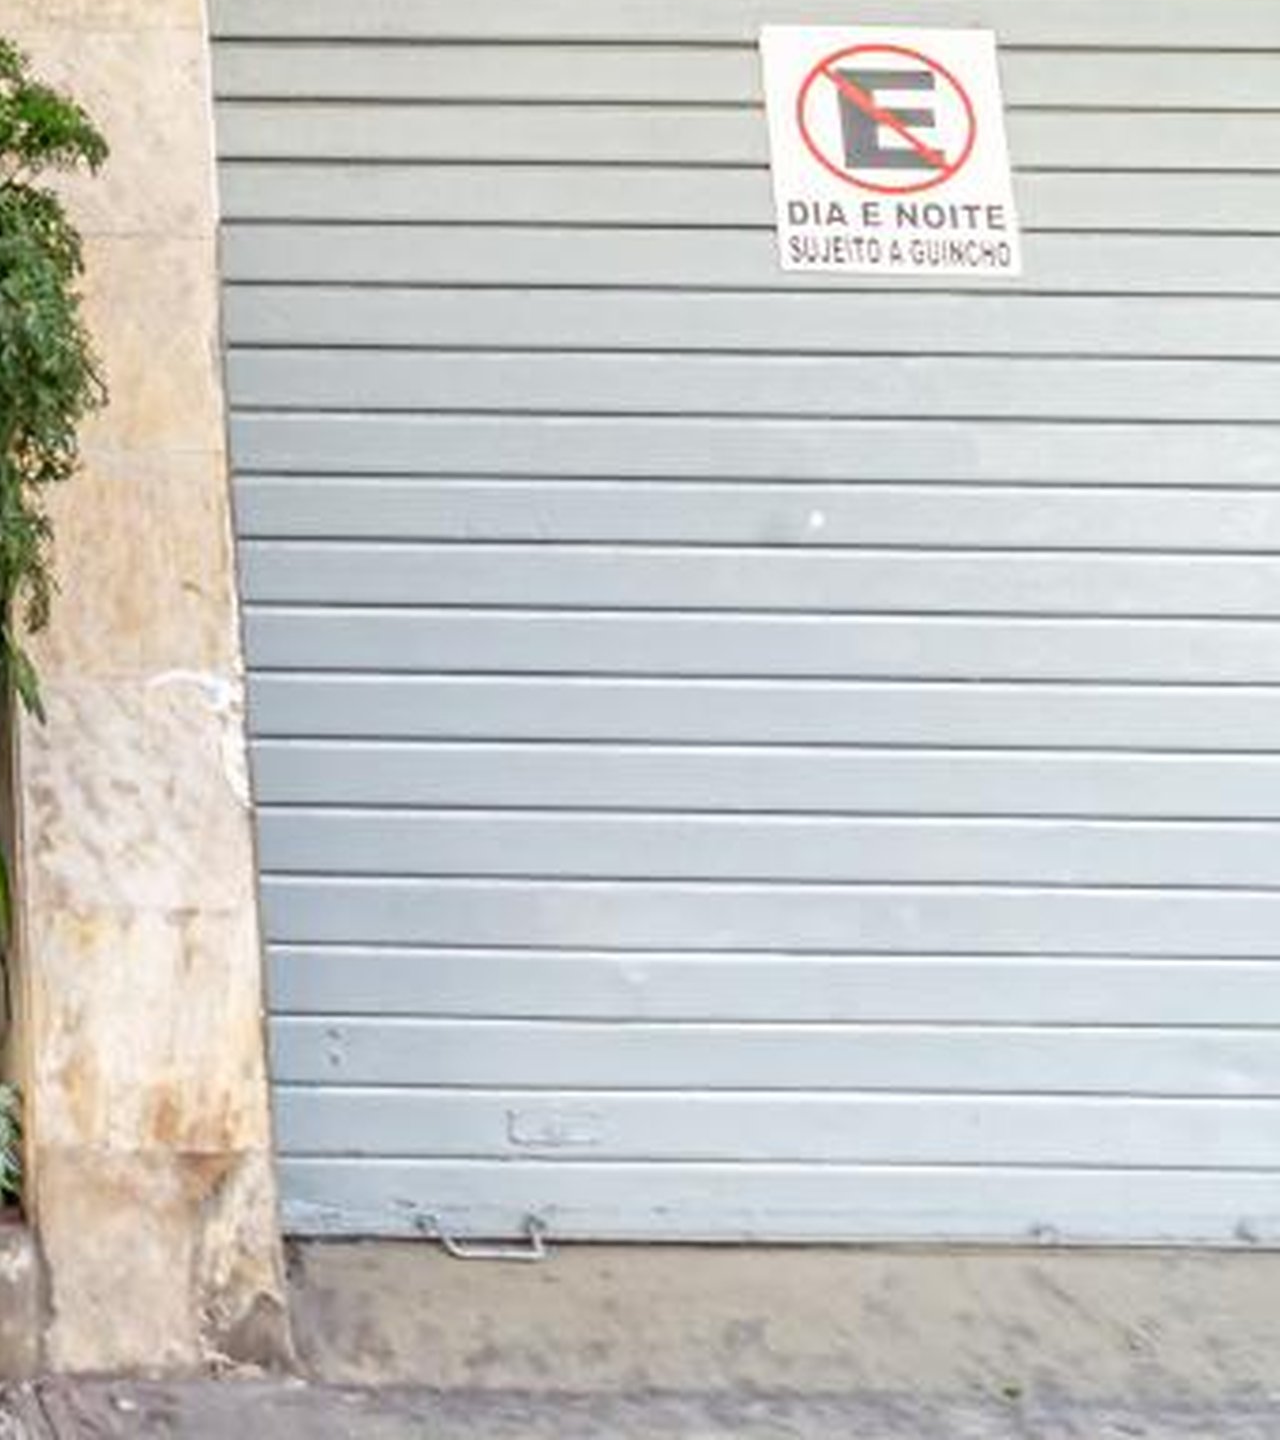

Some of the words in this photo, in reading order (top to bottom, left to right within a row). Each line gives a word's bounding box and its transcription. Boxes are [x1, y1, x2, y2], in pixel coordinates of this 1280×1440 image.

[788, 201, 848, 226] DIA
[861, 202, 883, 227] E
[897, 203, 1006, 230] NOITE
[789, 235, 881, 263] SUJEITO
[889, 240, 903, 263] A
[909, 240, 1011, 267] GUINCHO
